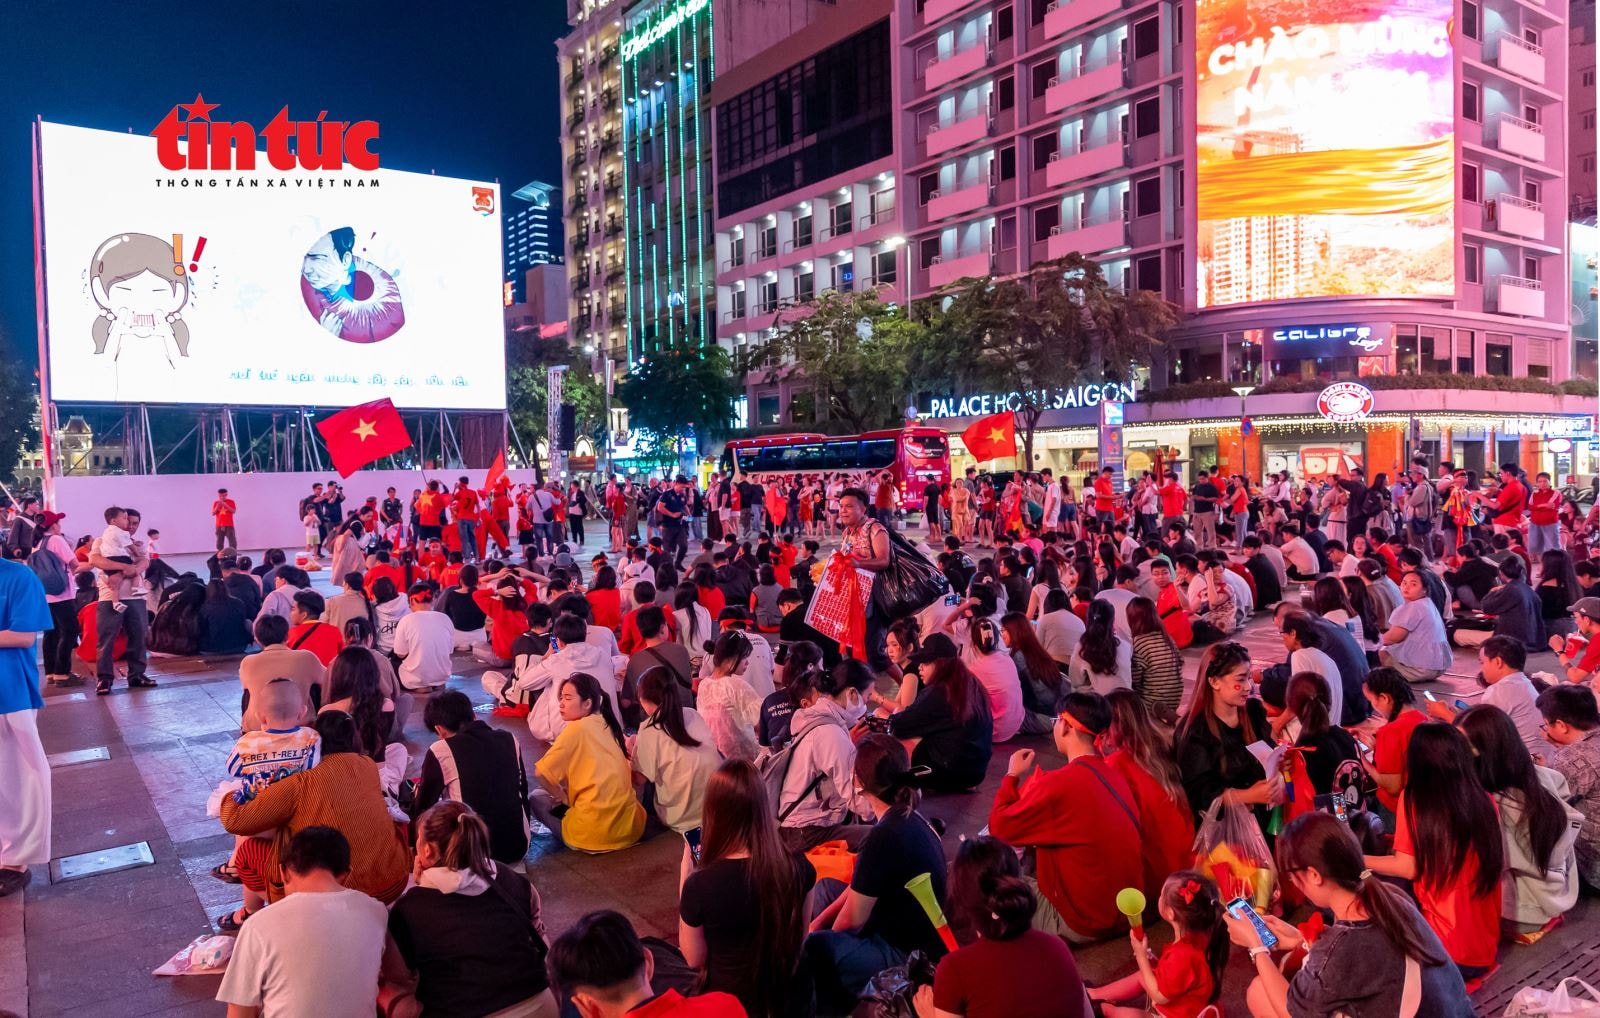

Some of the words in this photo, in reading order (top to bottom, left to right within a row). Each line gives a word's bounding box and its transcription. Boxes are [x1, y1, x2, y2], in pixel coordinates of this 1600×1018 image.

[1208, 26, 1330, 75] CHÀO
[931, 394, 991, 417] PALACE
[995, 390, 1051, 414] HOL
[1053, 382, 1136, 410] SAIGON
[242, 752, 268, 762] T-REX
[271, 749, 298, 758] T-REX
